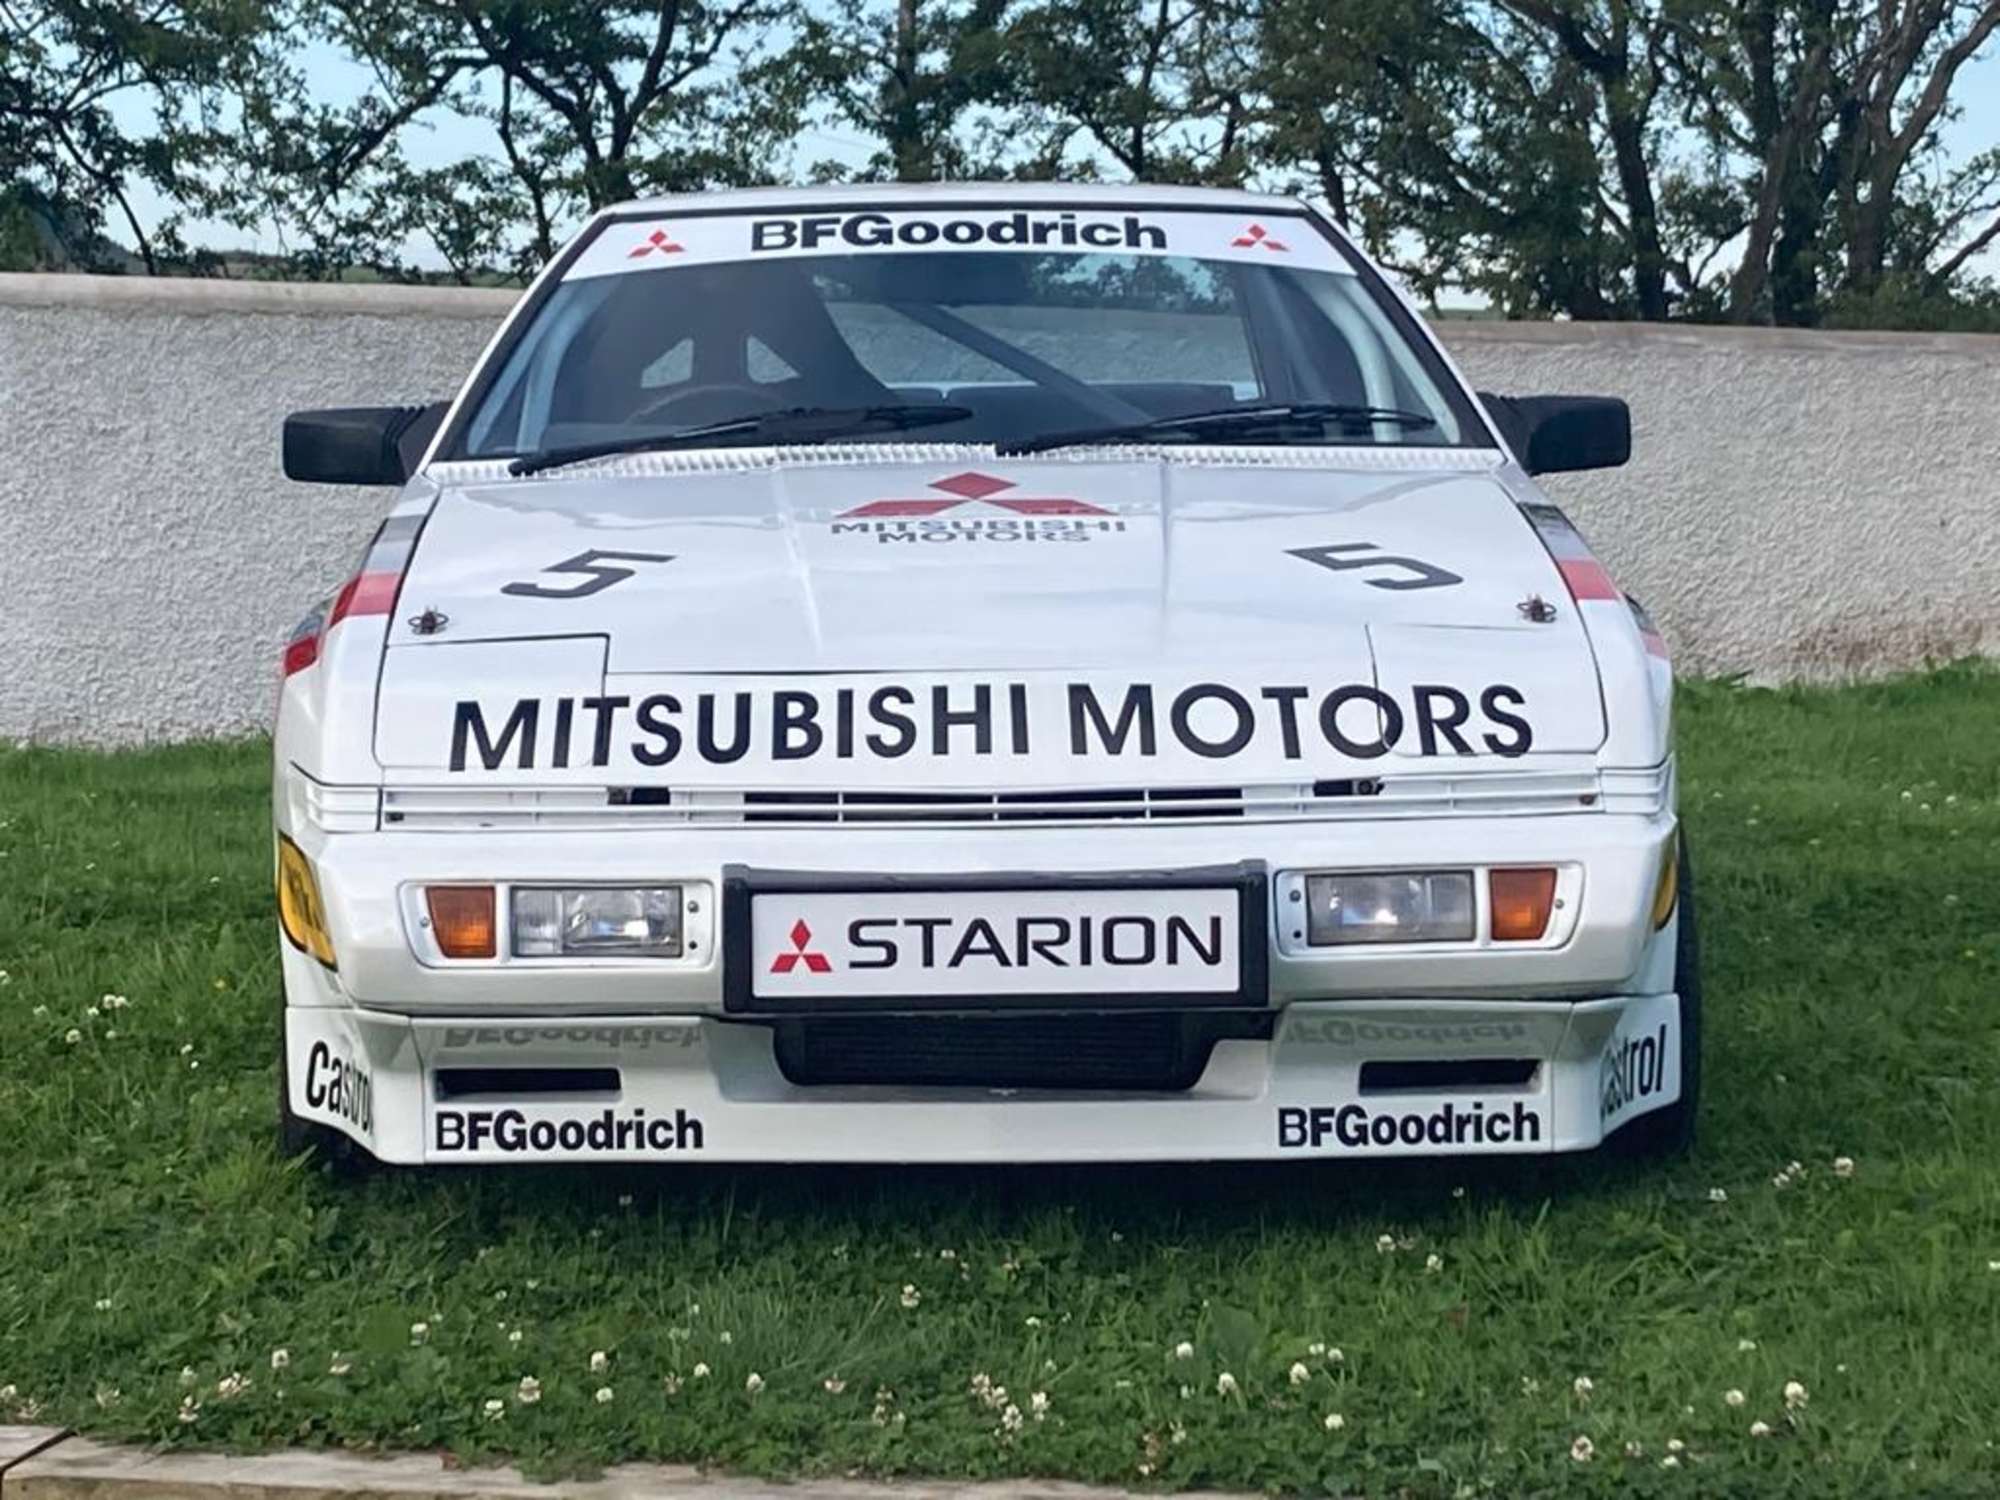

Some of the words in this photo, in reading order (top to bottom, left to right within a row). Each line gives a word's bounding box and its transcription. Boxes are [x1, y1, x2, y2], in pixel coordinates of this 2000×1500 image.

[752, 213, 1168, 255] BFGoodrich
[831, 519, 1126, 534] MITSUBISHI
[877, 531, 1091, 544] MOTORS
[501, 549, 676, 599] 5
[1285, 542, 1463, 591] 5
[450, 684, 1030, 771] MITSUBISHI
[1068, 683, 1533, 759] MOTORS
[848, 915, 1222, 969] STARION
[436, 1109, 704, 1151] BFGoodrich
[1278, 1101, 1541, 1148] BFGoodrich
